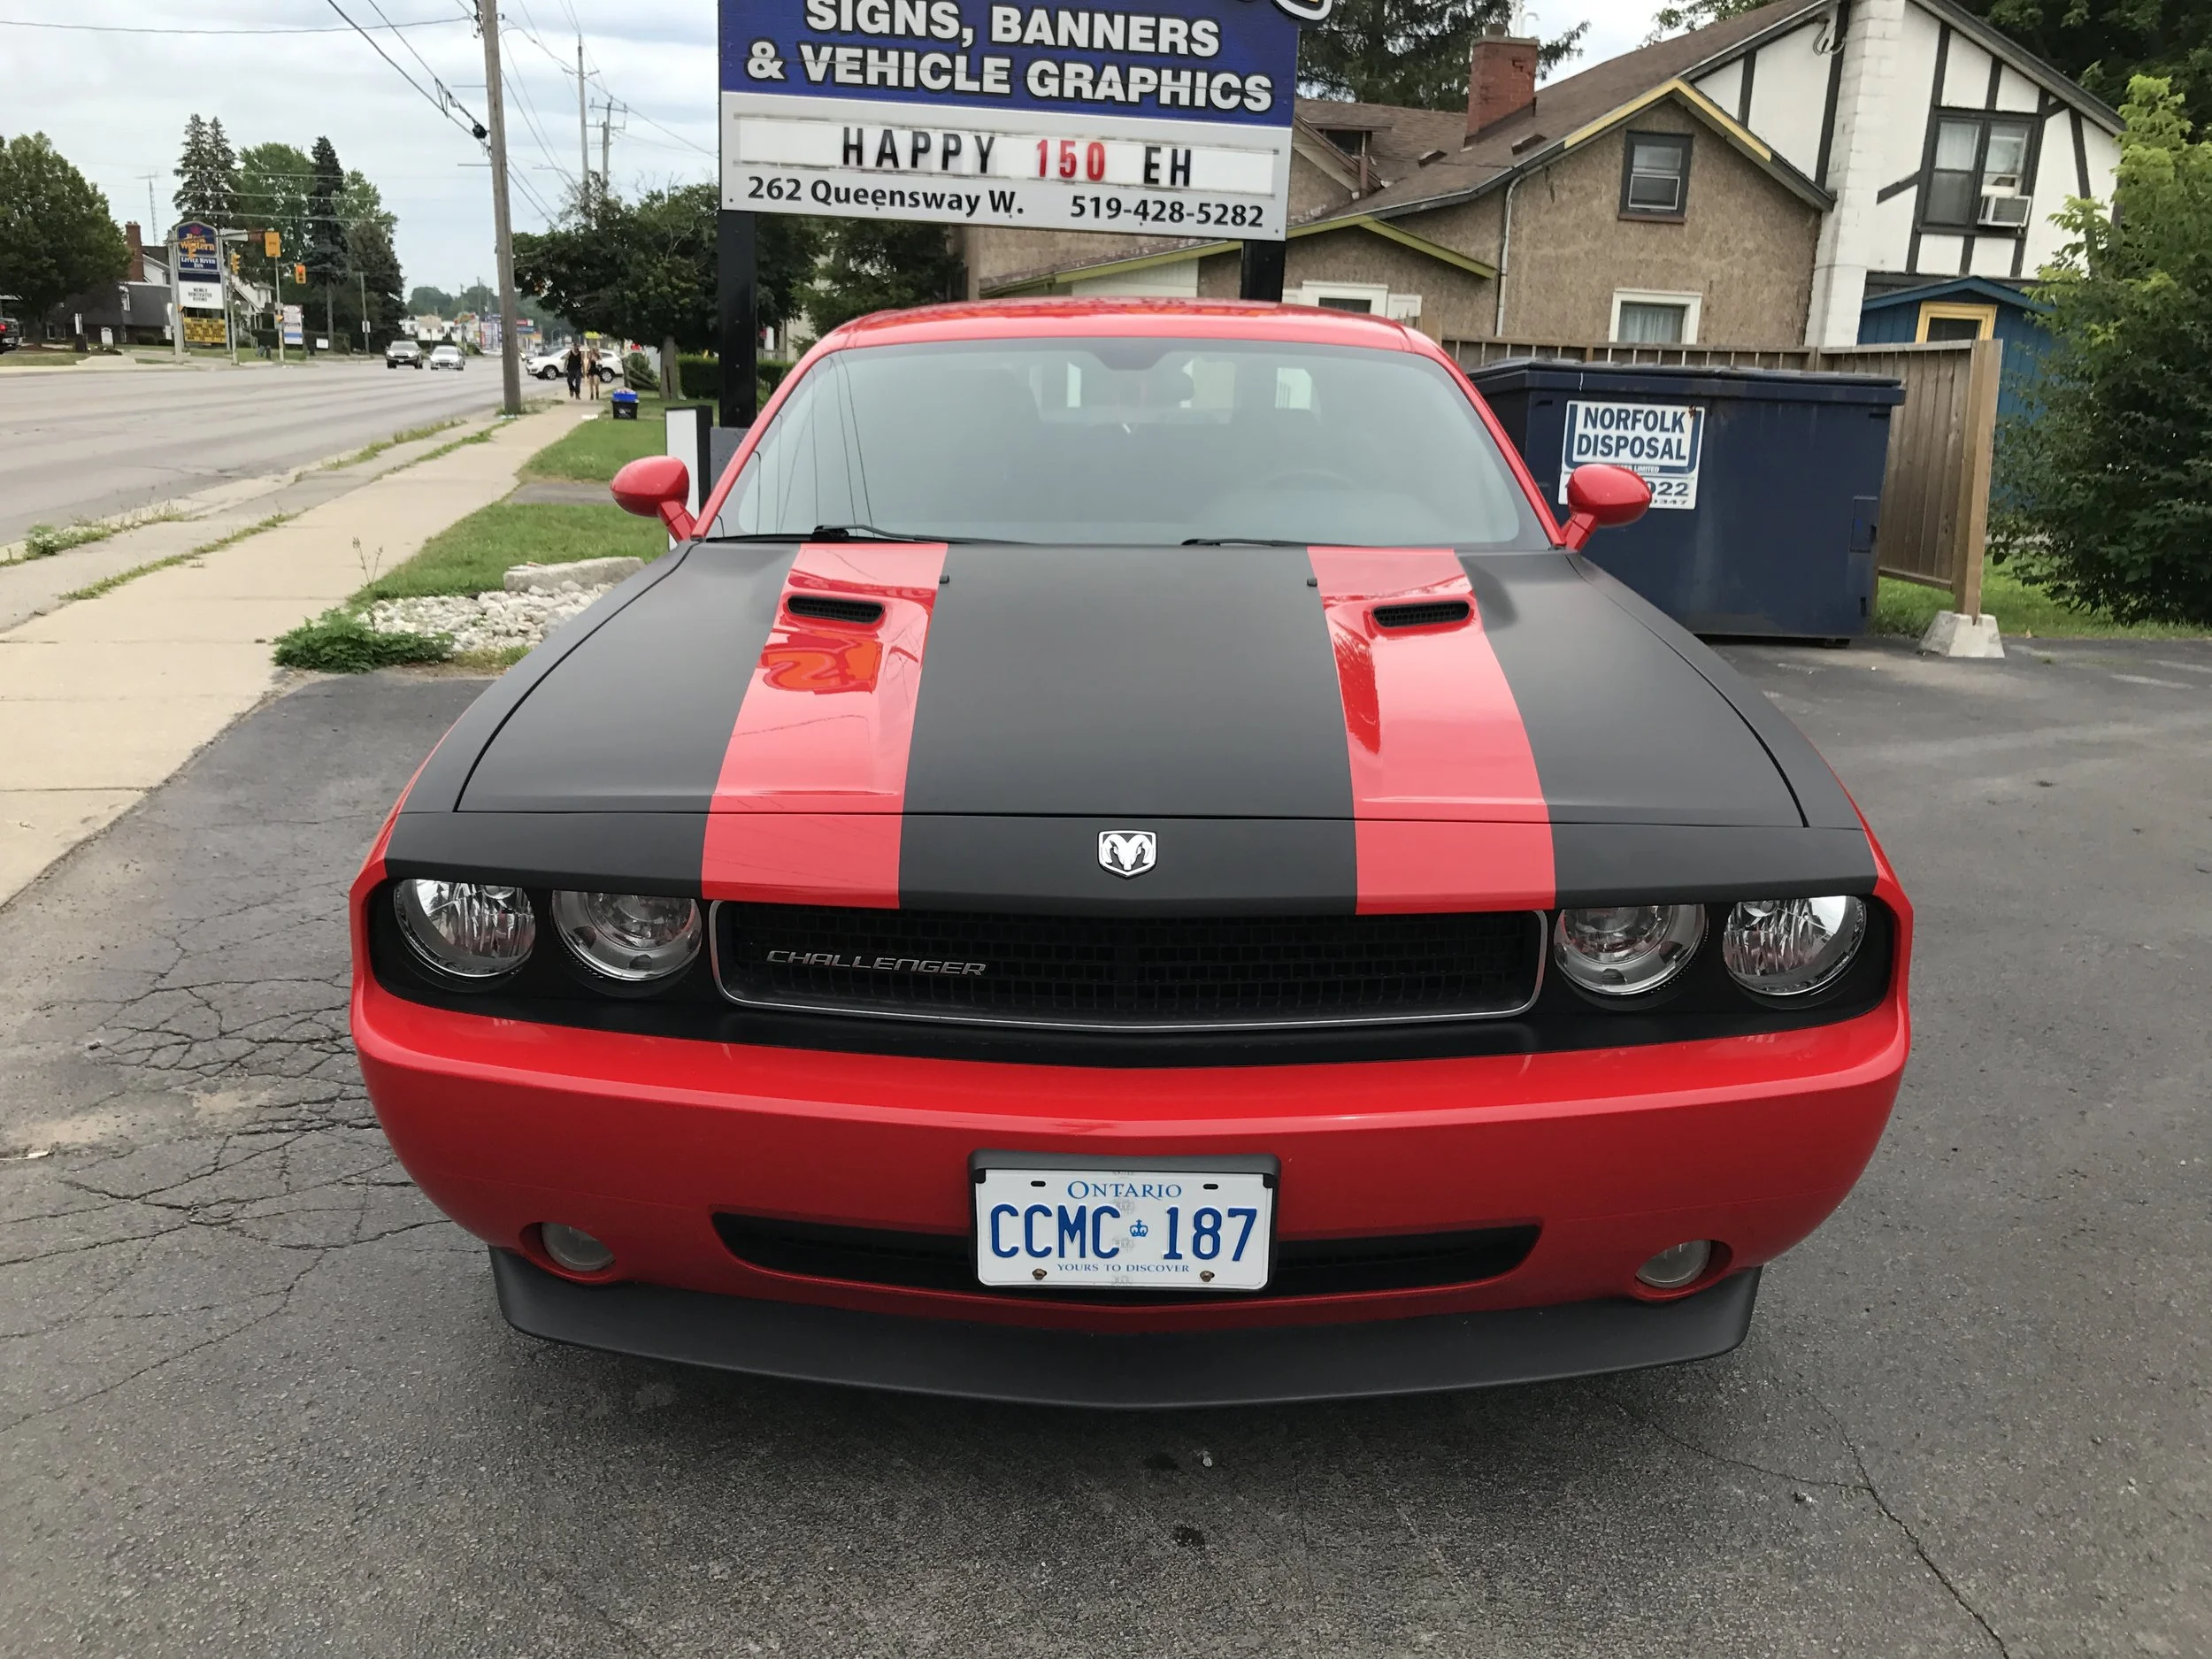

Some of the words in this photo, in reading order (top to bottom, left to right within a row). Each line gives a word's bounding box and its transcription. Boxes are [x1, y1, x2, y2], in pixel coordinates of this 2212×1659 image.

[805, 0, 974, 49] SIGNS,
[990, 5, 1220, 58] BANNERS
[747, 41, 786, 80] &
[799, 44, 1011, 95] VEHICLE
[1025, 59, 1272, 113] GRAPHICS
[842, 127, 995, 174] HAPPY
[1036, 138, 1106, 182] 150
[1143, 145, 1192, 188] EH
[748, 175, 802, 202] 262
[810, 179, 981, 219] Queensway
[988, 188, 1025, 215] W.
[1070, 195, 1264, 228] 519-428-5282
[1583, 406, 1686, 434] NORFOLK
[1576, 434, 1687, 461] DISPOSAL
[766, 949, 987, 976] CHALLENGER
[989, 1203, 1122, 1260] CCMC
[1162, 1206, 1258, 1263] 187
[1056, 1263, 1099, 1272] YOURS
[1103, 1263, 1122, 1272] TO
[1125, 1263, 1190, 1273] DISCOVER
